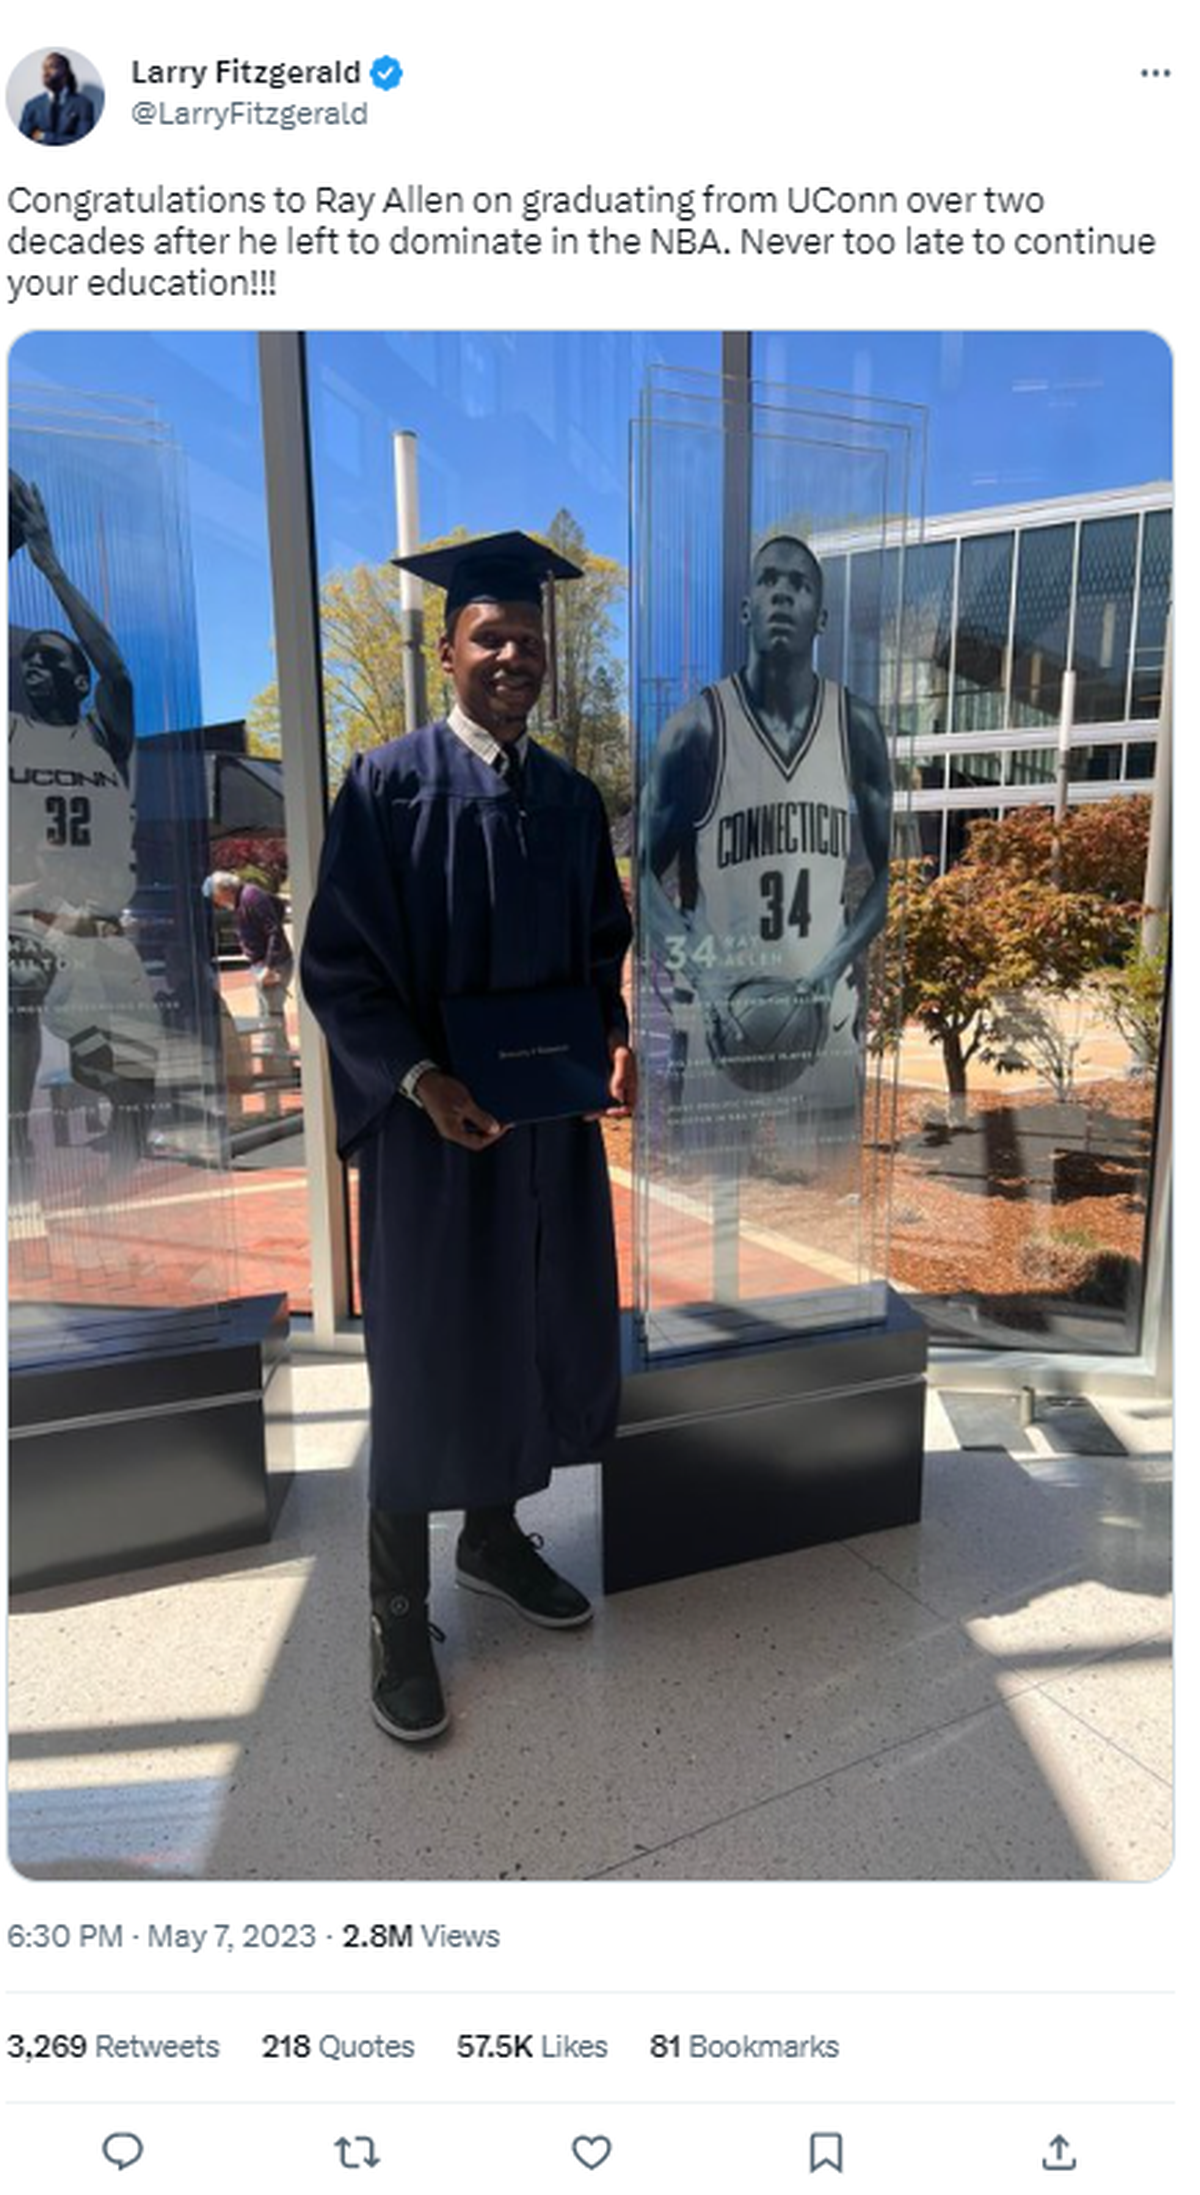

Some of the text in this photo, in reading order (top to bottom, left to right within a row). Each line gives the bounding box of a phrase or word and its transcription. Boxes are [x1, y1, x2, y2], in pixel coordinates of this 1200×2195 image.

[9, 766, 119, 787] UCONN
[45, 796, 91, 846] 32
[717, 802, 848, 870] CONNECTICUT
[760, 868, 811, 941] 34
[664, 935, 717, 970] 34
